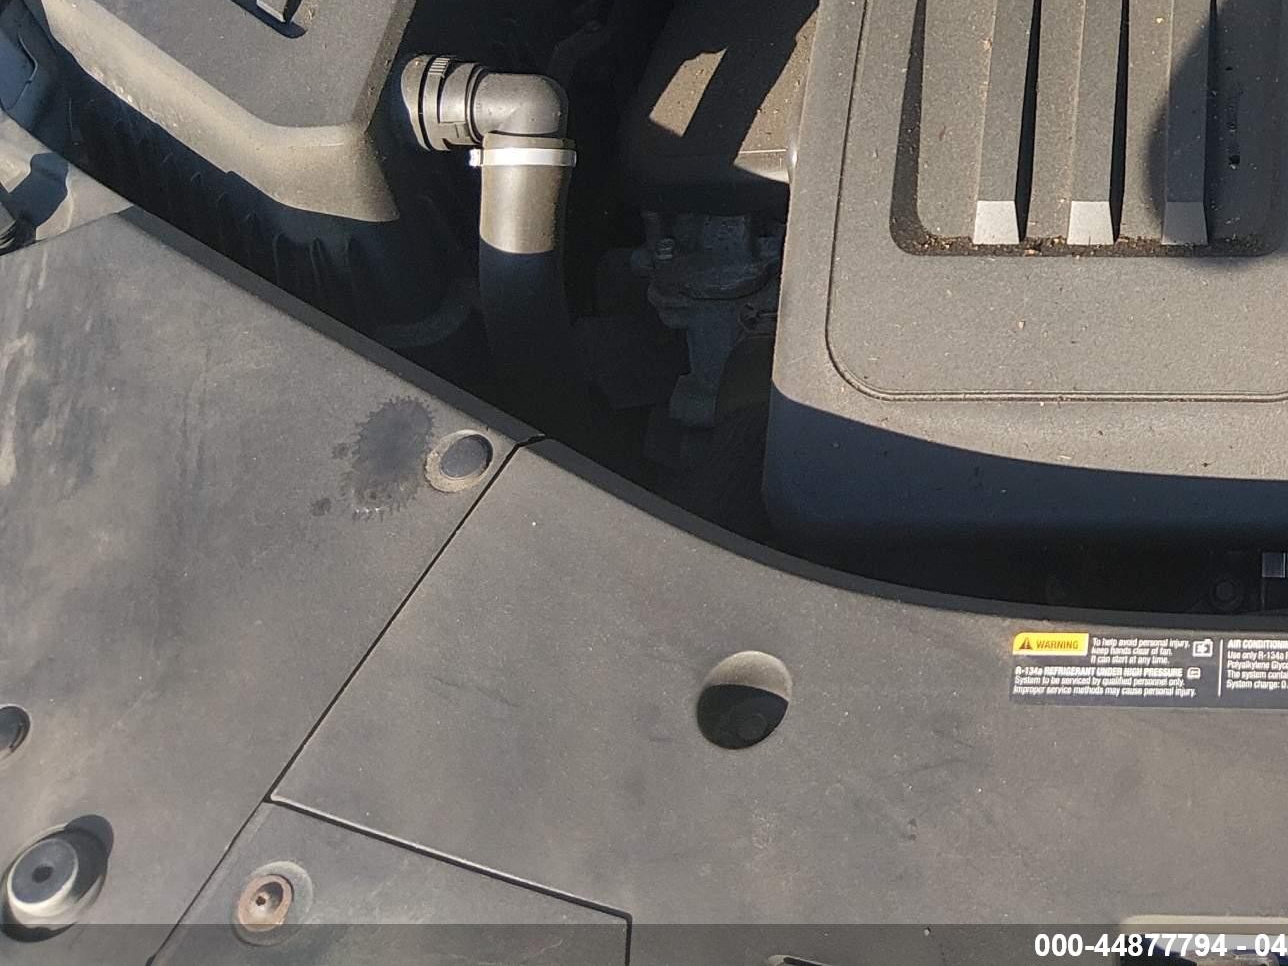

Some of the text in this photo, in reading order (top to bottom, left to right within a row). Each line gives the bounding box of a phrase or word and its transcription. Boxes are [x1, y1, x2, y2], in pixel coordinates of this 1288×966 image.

[1036, 640, 1079, 650] WARNING
[1093, 637, 1191, 649] To help avoid personal injury,
[1227, 639, 1241, 649] AIR
[1091, 646, 1173, 656] keep hands clear of fan.
[1227, 651, 1241, 660] Use
[1241, 651, 1257, 661] only
[1258, 651, 1284, 660] R-134a
[1097, 656, 1110, 664] can
[1111, 655, 1128, 664] start
[1129, 656, 1137, 664] at
[1137, 657, 1151, 666] any
[1152, 656, 1170, 665] time.
[1227, 660, 1270, 670] Polyalkylene
[1015, 666, 1183, 677] R-134a REFRIGERANT UNDER HIGH PRESSURE
[1226, 670, 1240, 679] The
[1241, 671, 1266, 680] system
[1014, 675, 1185, 687] System to be serviced by qualified personnel only.
[1226, 680, 1253, 690] System
[1253, 680, 1280, 691] charge:
[1013, 685, 1197, 698] Improper service methods may cause personal injury.
